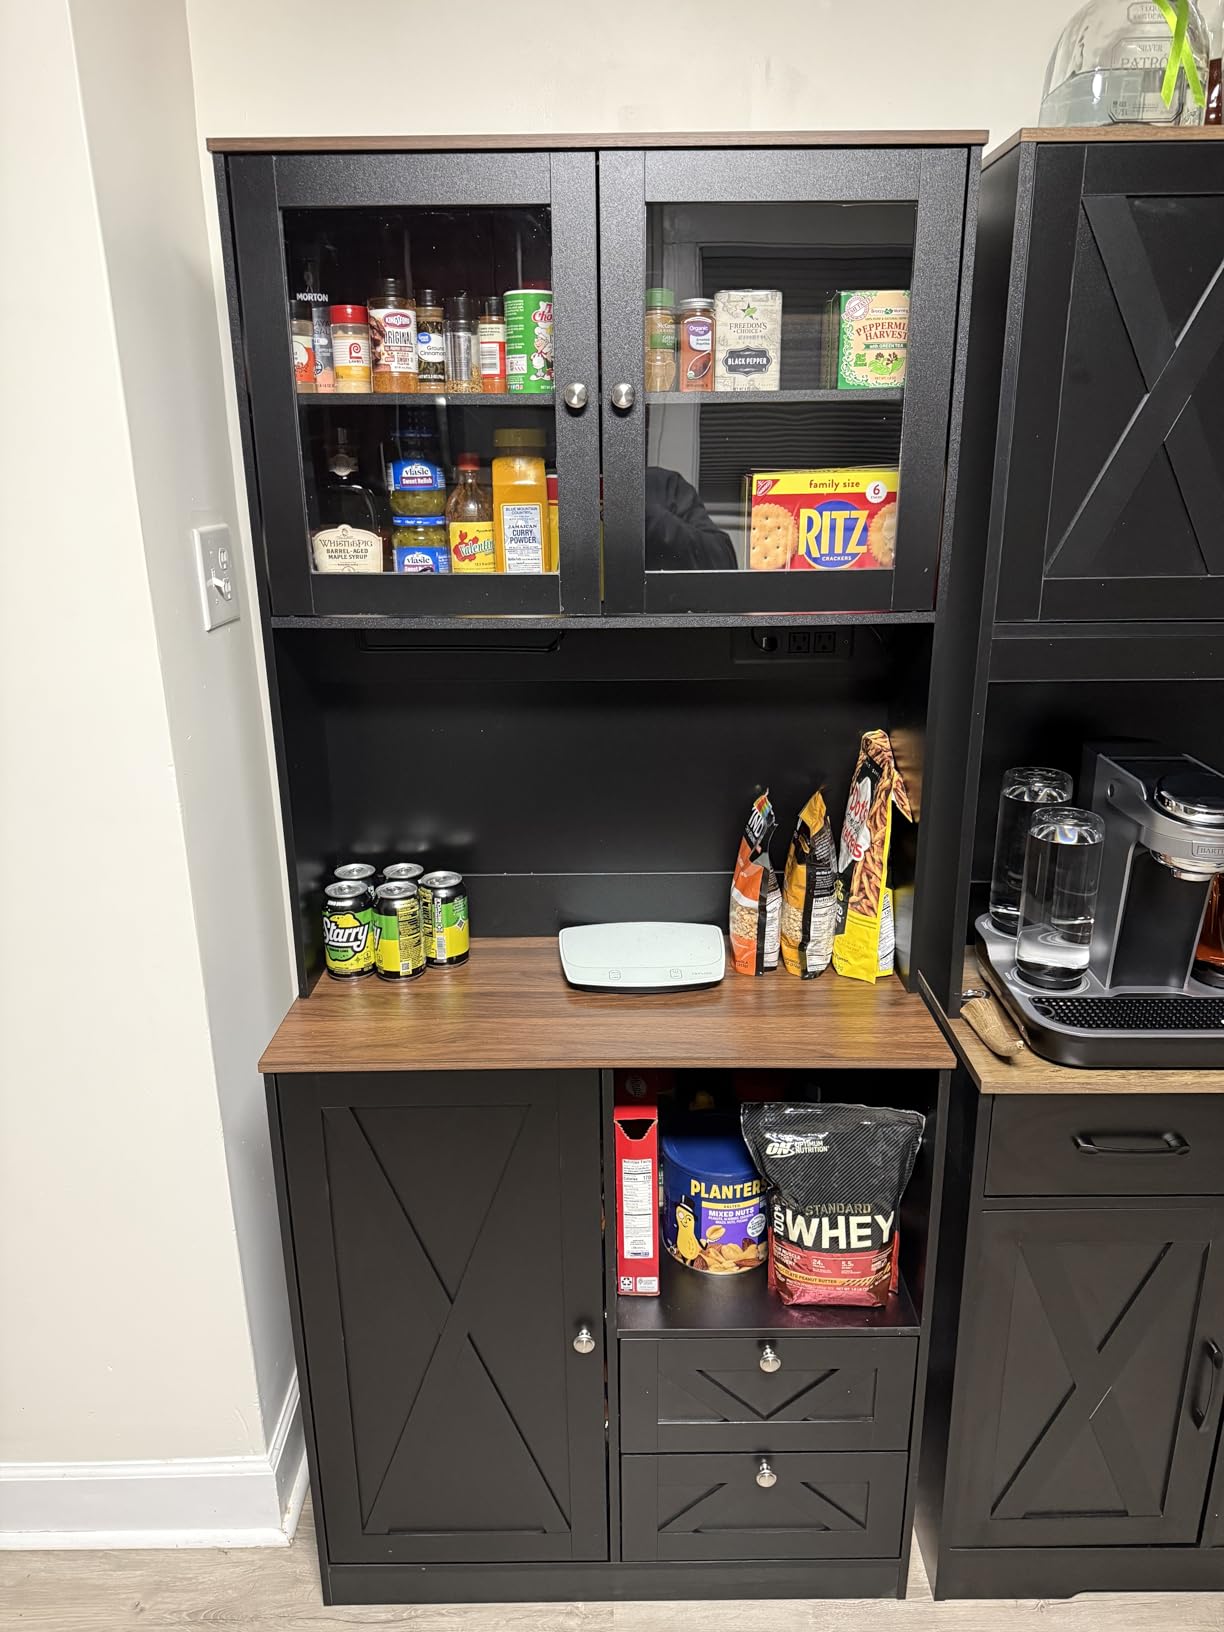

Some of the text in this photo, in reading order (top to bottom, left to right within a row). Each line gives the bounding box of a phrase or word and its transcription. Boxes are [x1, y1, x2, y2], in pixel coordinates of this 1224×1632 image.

[1138, 44, 1164, 53] SILVER
[1121, 53, 1168, 70] PATRÓ
[296, 292, 329, 302] MORTON
[729, 321, 768, 330] FREEDOM'S
[855, 321, 908, 336] PEPPERMI
[383, 330, 413, 345] ORIGINAL
[865, 330, 908, 341] HARVEST
[727, 357, 768, 365] BLACK PEPPER
[809, 479, 861, 492] family size
[872, 483, 881, 496] 6
[512, 529, 534, 537] CURRY
[798, 508, 870, 558] RITZ
[509, 536, 537, 545] POWDER
[748, 807, 764, 838] IND
[323, 917, 369, 953] Starry
[794, 1145, 829, 1154] NUTRITION
[708, 1206, 755, 1218] MIXED NUTS
[805, 1202, 873, 1216] STANDARD
[785, 1209, 895, 1250] WHEY
